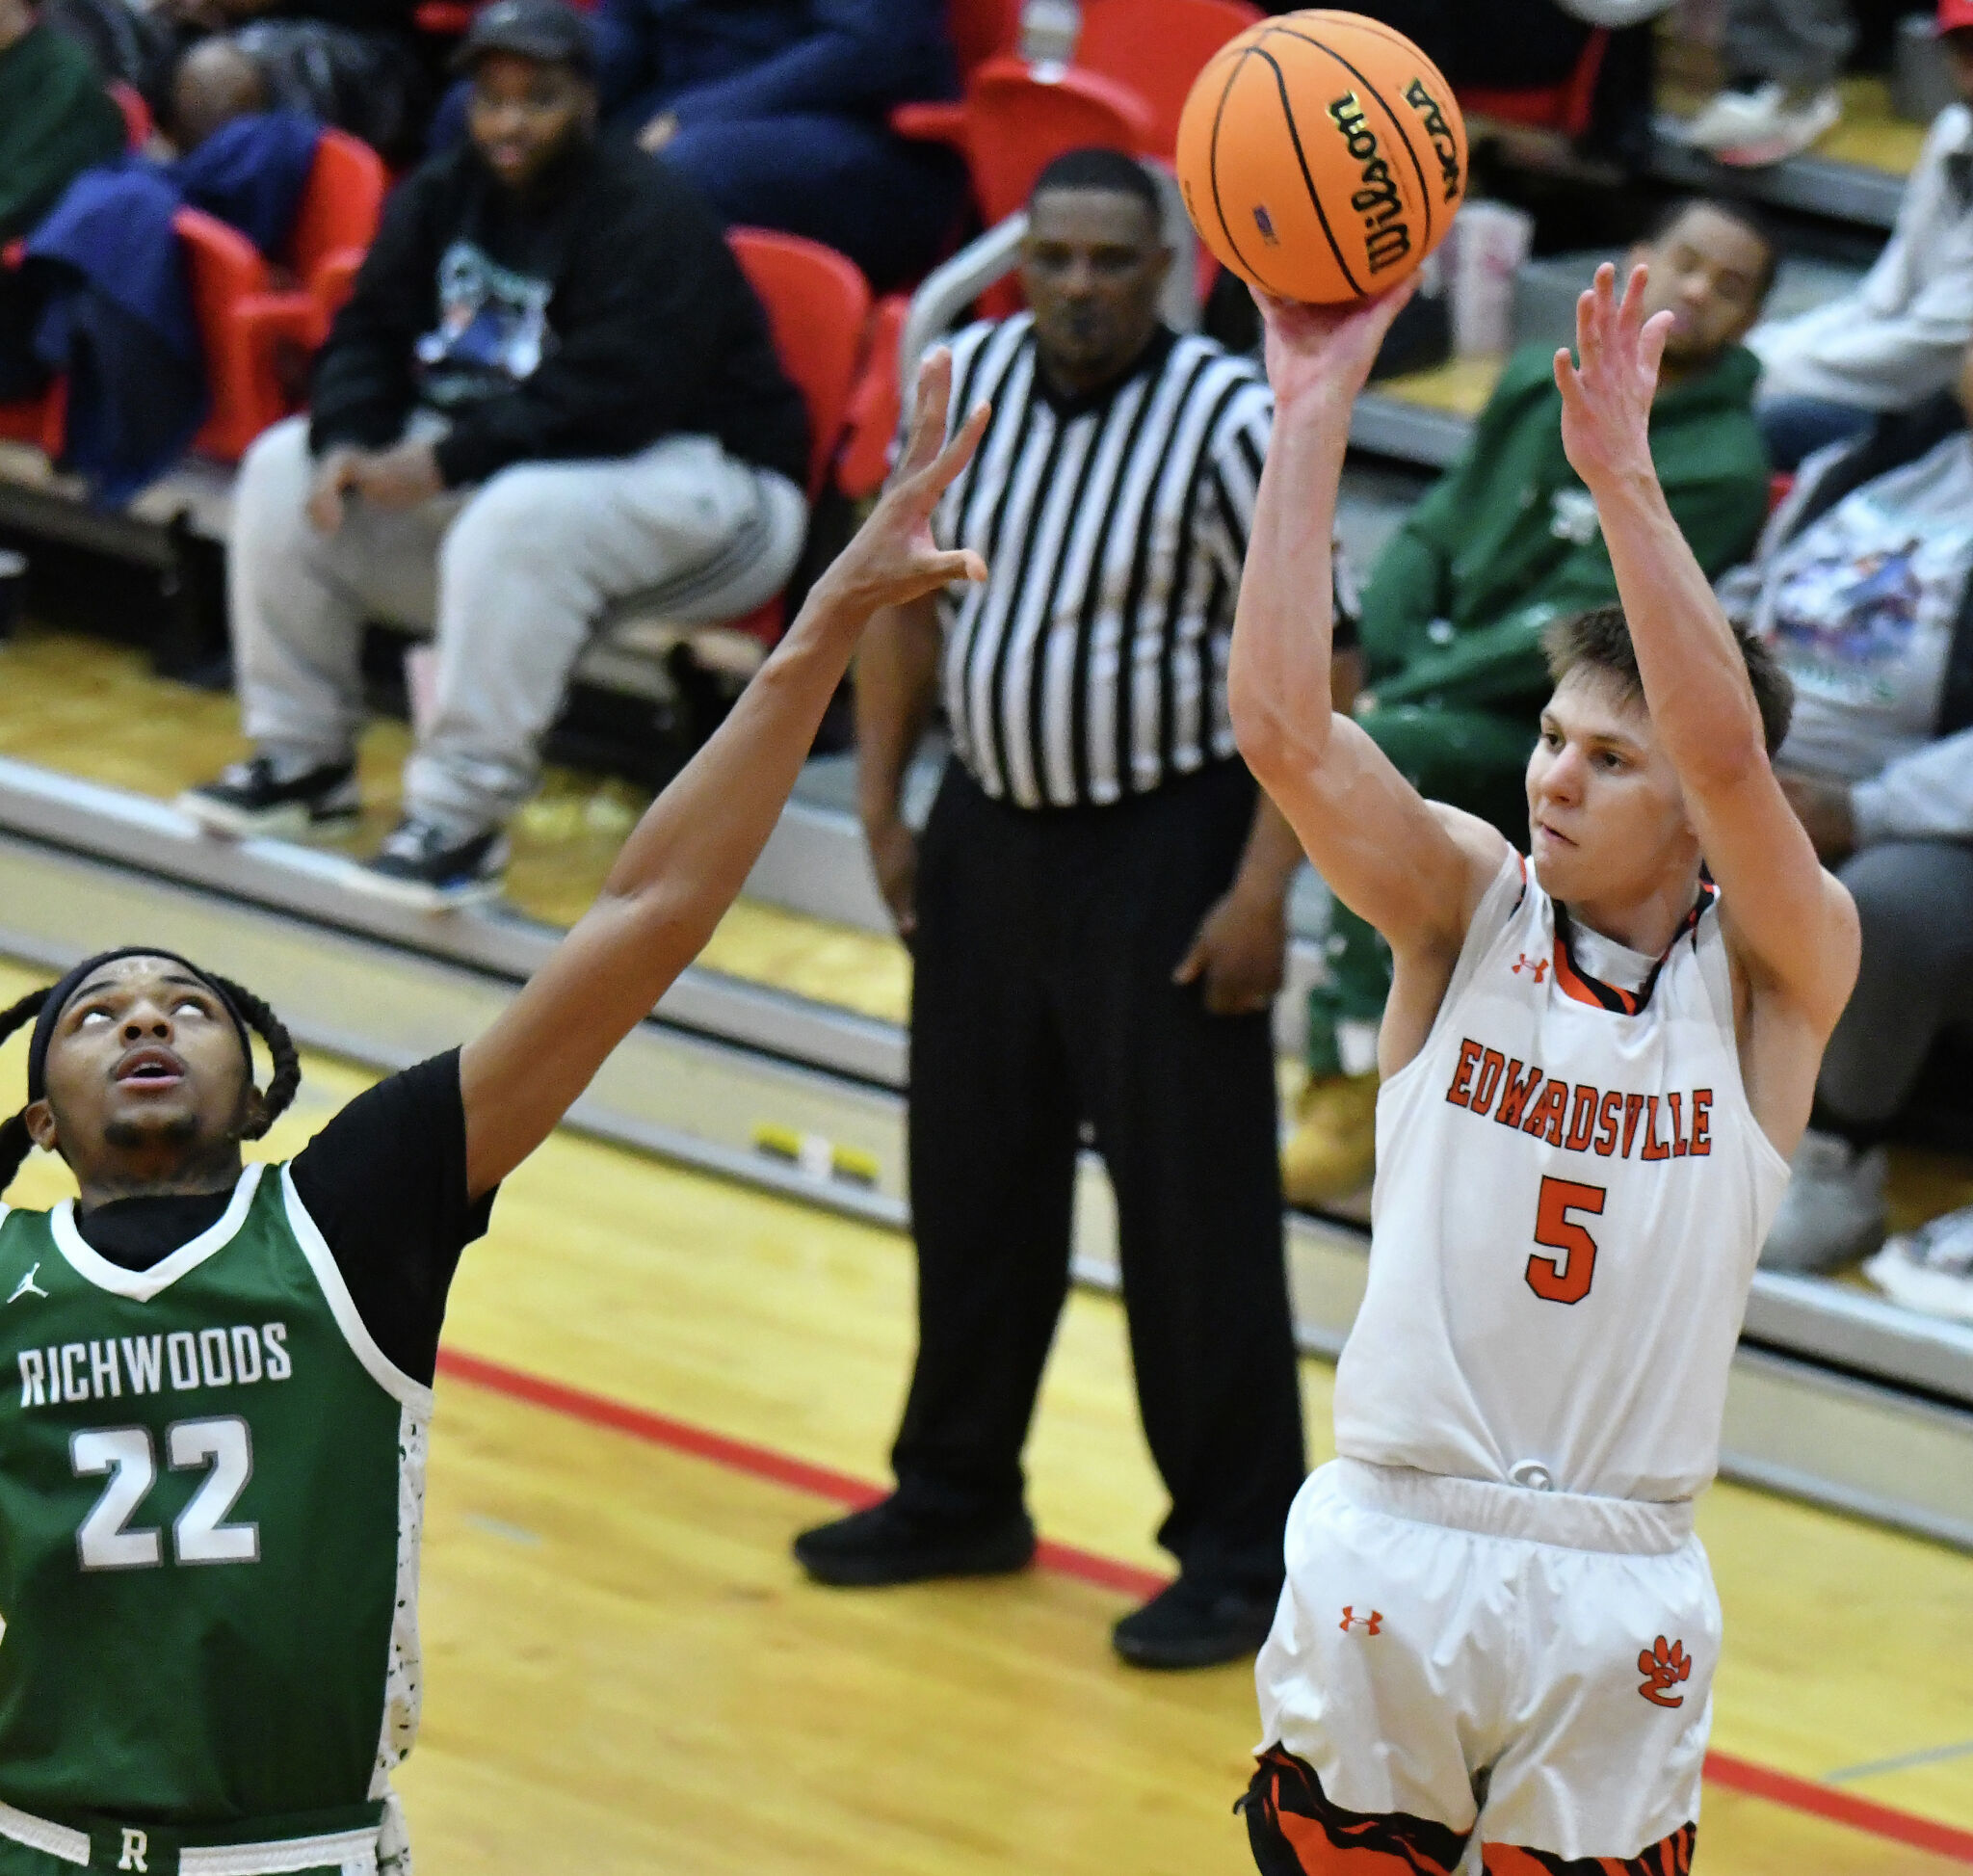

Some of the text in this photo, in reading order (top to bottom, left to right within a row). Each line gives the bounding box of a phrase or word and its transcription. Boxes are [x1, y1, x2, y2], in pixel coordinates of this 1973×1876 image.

[1326, 90, 1411, 276] Wilson
[1445, 1037, 1713, 1161] EDWARDSVLLE
[1525, 1175, 1607, 1306] 5
[16, 1322, 293, 1409] RICHWOODS
[68, 1414, 261, 1572] 22
[118, 1827, 148, 1873] R
